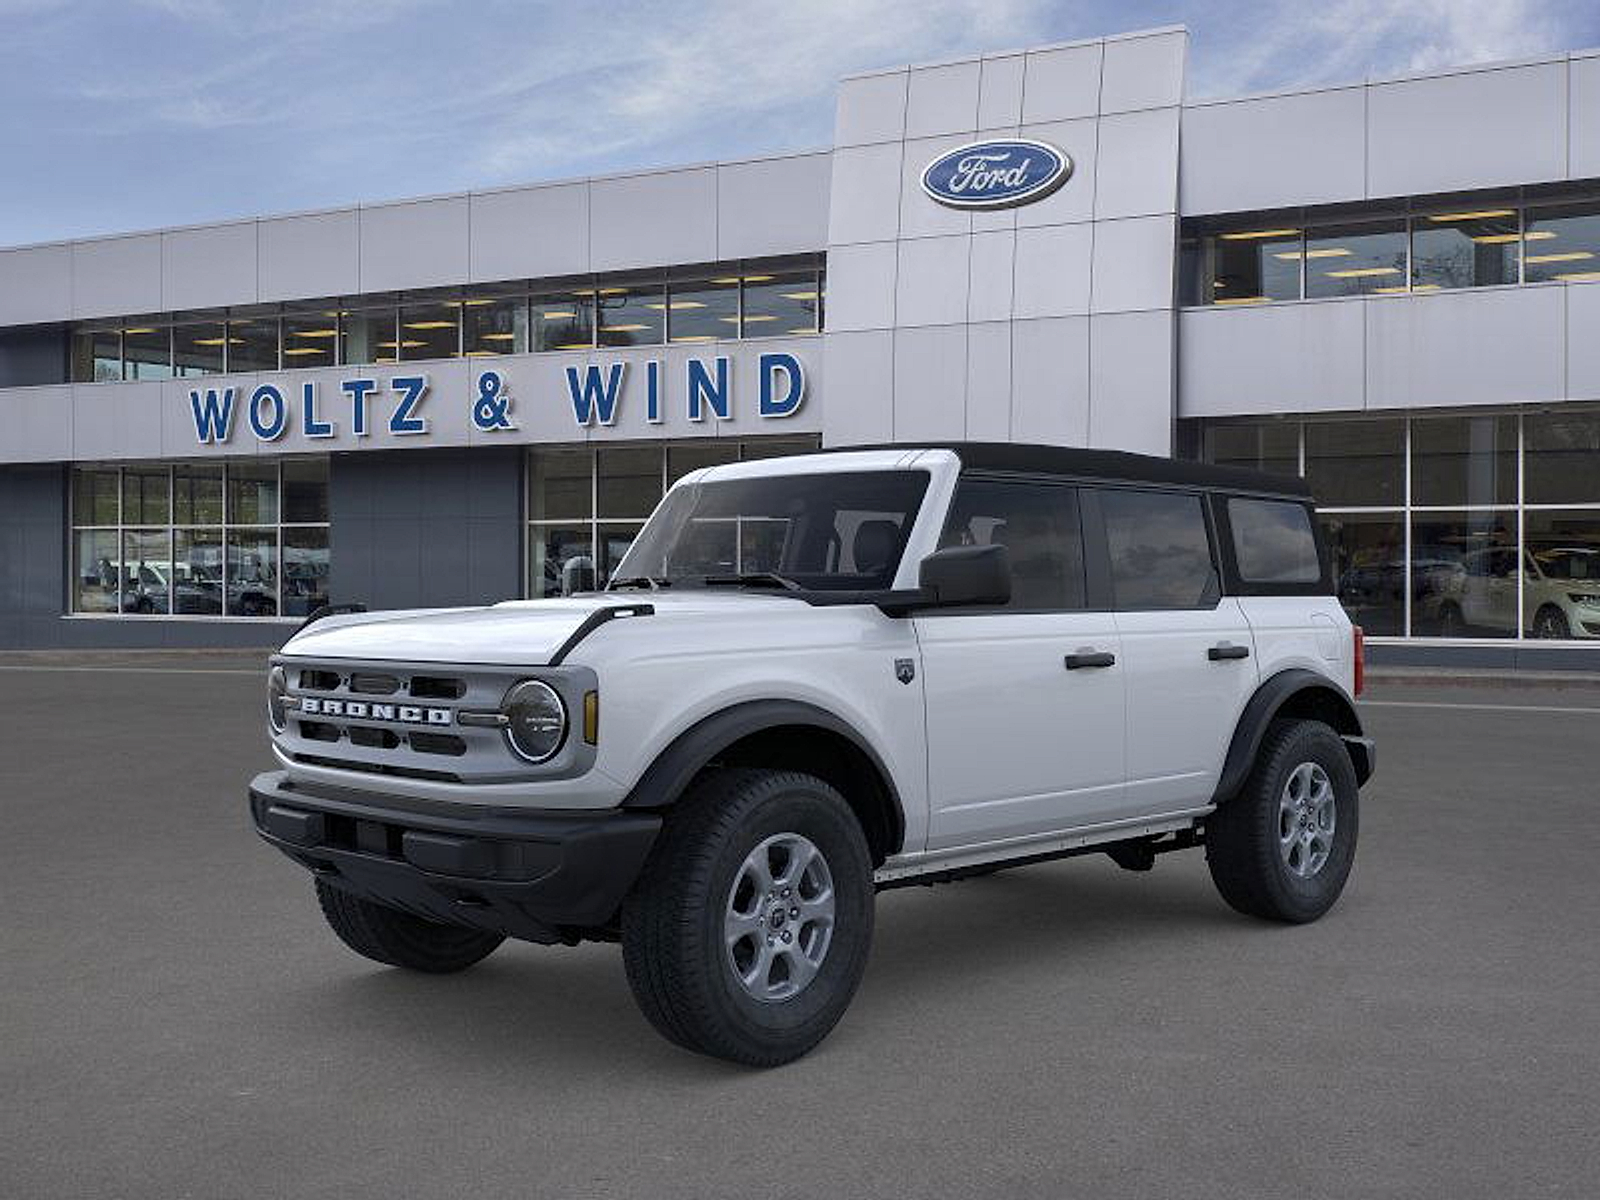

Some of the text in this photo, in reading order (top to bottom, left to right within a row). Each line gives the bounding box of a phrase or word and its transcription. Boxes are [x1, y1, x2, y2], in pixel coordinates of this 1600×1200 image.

[949, 152, 1031, 193] Ford
[190, 353, 806, 443] WOLTZ & WIND
[301, 698, 452, 724] BRONCO
